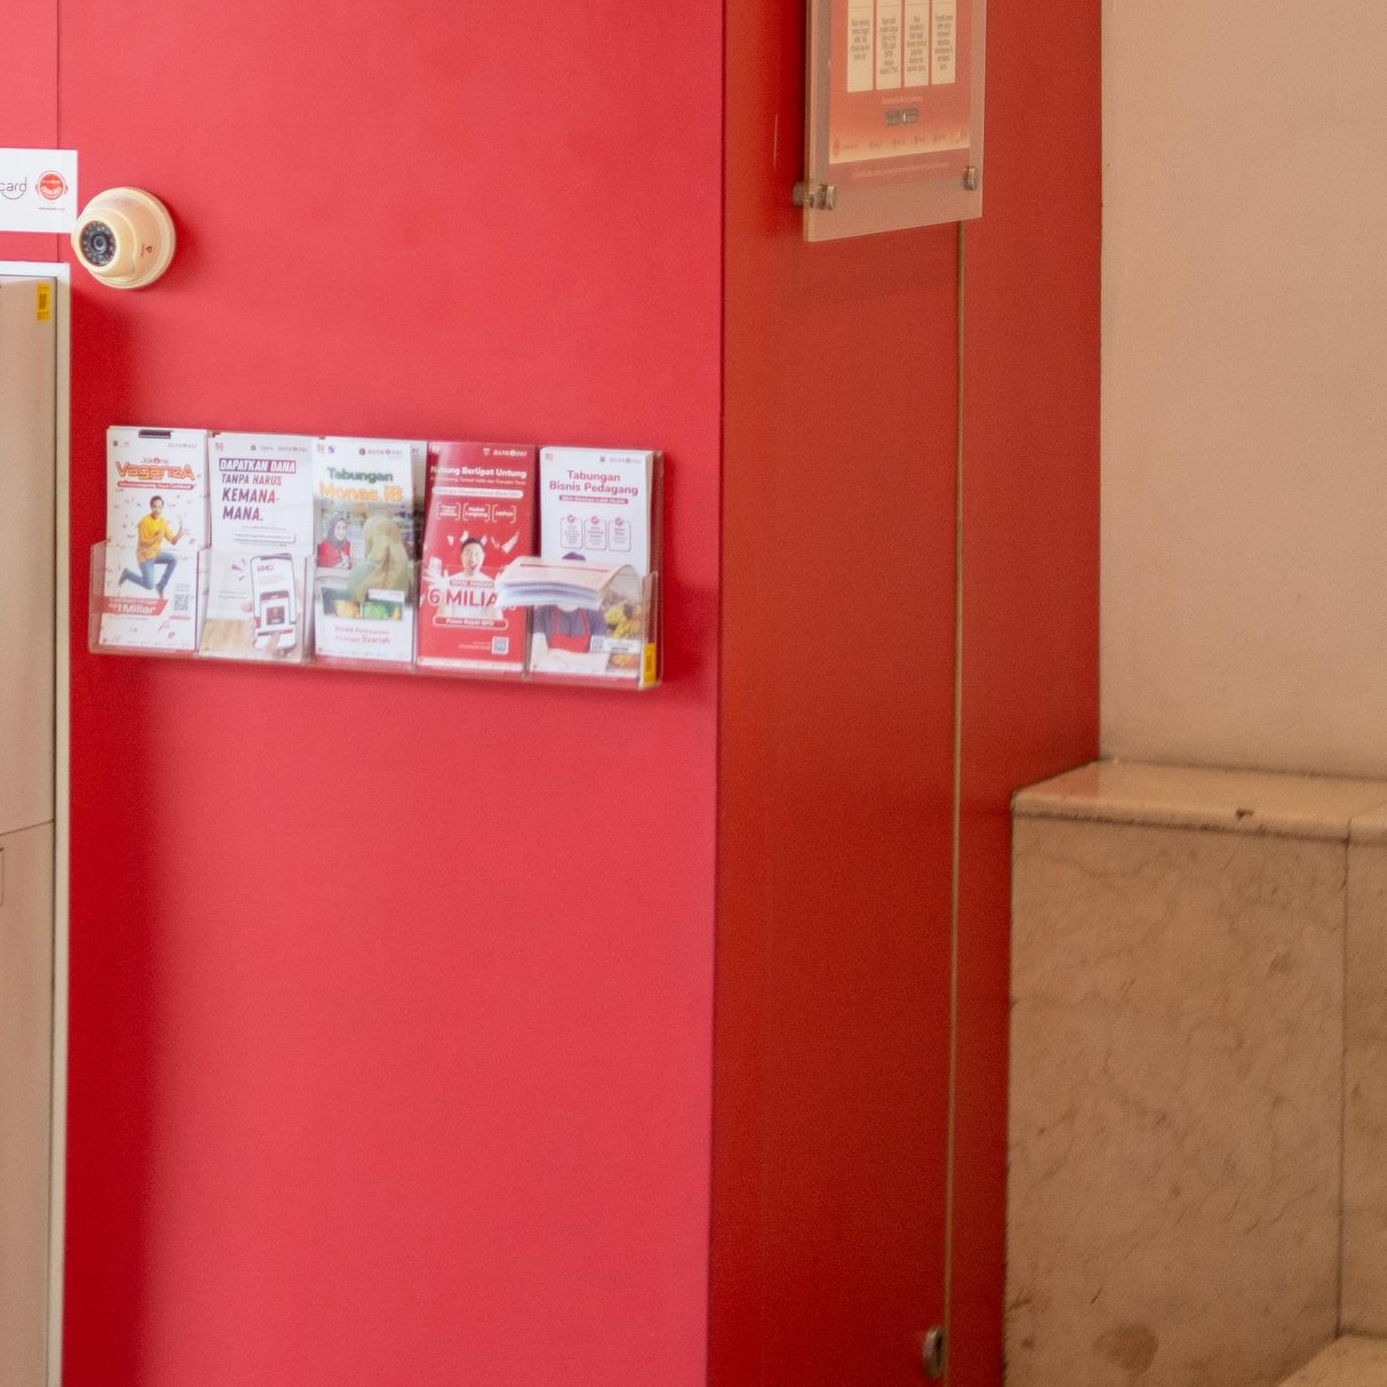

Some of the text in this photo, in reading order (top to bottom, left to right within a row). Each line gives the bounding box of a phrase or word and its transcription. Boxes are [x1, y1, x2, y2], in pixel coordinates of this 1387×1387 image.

[219, 459, 296, 474] DAPATKAN DANA
[495, 468, 527, 480] Untung
[221, 473, 283, 486] TANPA HARUS
[327, 467, 394, 484] Tabungan
[566, 469, 621, 483] Tabungan
[319, 480, 379, 501] Monas
[549, 480, 638, 496] Bisnis Pedagang
[222, 504, 264, 522] MANA.
[429, 588, 498, 607] 6 MILIA
